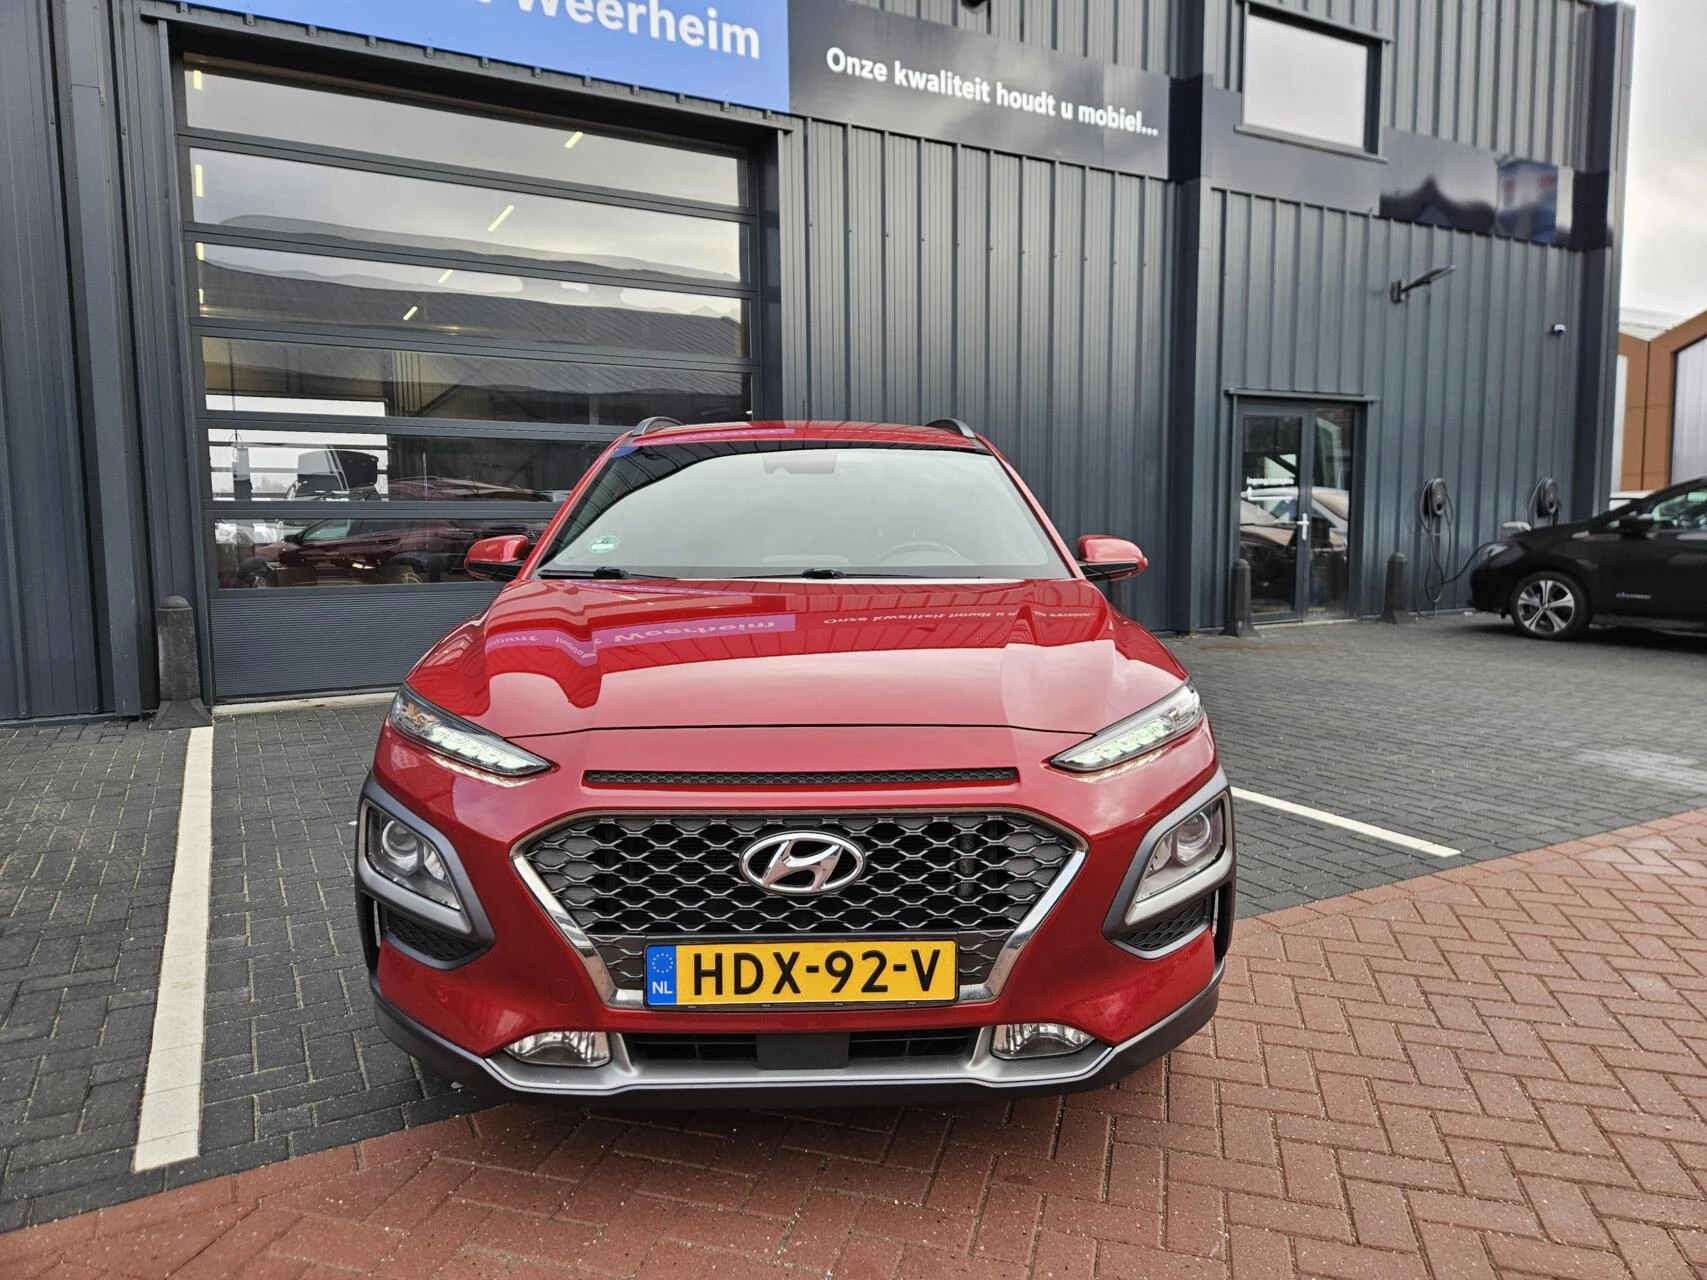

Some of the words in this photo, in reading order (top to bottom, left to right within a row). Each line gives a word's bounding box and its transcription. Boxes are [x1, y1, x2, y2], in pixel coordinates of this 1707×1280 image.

[826, 47, 887, 82] Onze
[894, 60, 990, 104] kwaliteit
[996, 82, 1056, 117] houdt
[1061, 101, 1074, 120] u
[1078, 104, 1159, 136] mobiel...
[651, 981, 673, 995] NL
[693, 949, 940, 995] HDX-92-V
